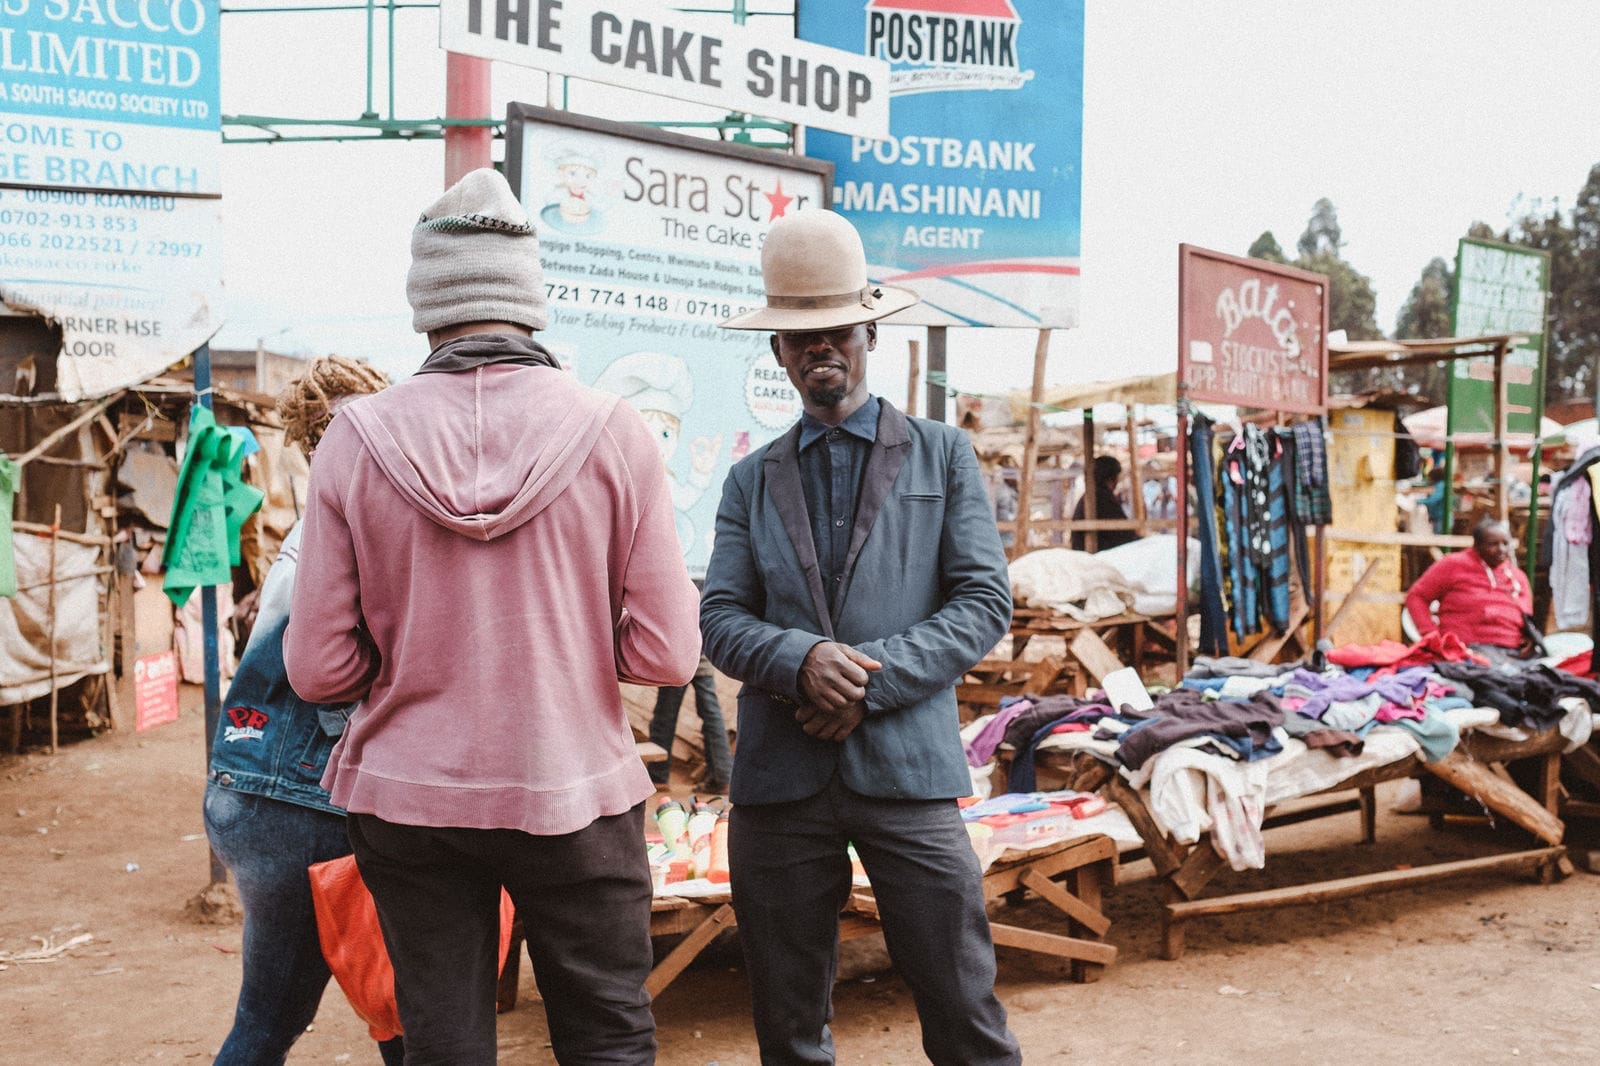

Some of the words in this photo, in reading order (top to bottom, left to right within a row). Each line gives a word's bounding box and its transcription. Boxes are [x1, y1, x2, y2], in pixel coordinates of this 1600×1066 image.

[869, 11, 1016, 68] POSTBANK
[0, 28, 201, 88] LIMITED
[591, 11, 722, 88] CAKE
[747, 48, 871, 118] SHOP
[11, 83, 65, 105] SOUTH
[68, 88, 117, 110] SACCO
[120, 93, 179, 116] SOCIETY
[182, 101, 209, 119] LTD
[0, 122, 75, 148] OME
[85, 129, 123, 151] TO
[852, 134, 1036, 172] POSTBANK
[45, 156, 199, 193] BRANCH
[624, 157, 709, 213] Sara
[843, 181, 1041, 219] MASHINANI
[104, 216, 137, 232] 853
[661, 217, 698, 241] The
[706, 224, 751, 249] Cake
[902, 226, 984, 250] AGENT
[40, 234, 122, 253] 2022521
[618, 268, 649, 282] House
[590, 288, 625, 306] 774
[635, 295, 668, 312] 148
[687, 300, 731, 319] 0718
[125, 319, 161, 336] HSE
[754, 385, 795, 401] CAKES
